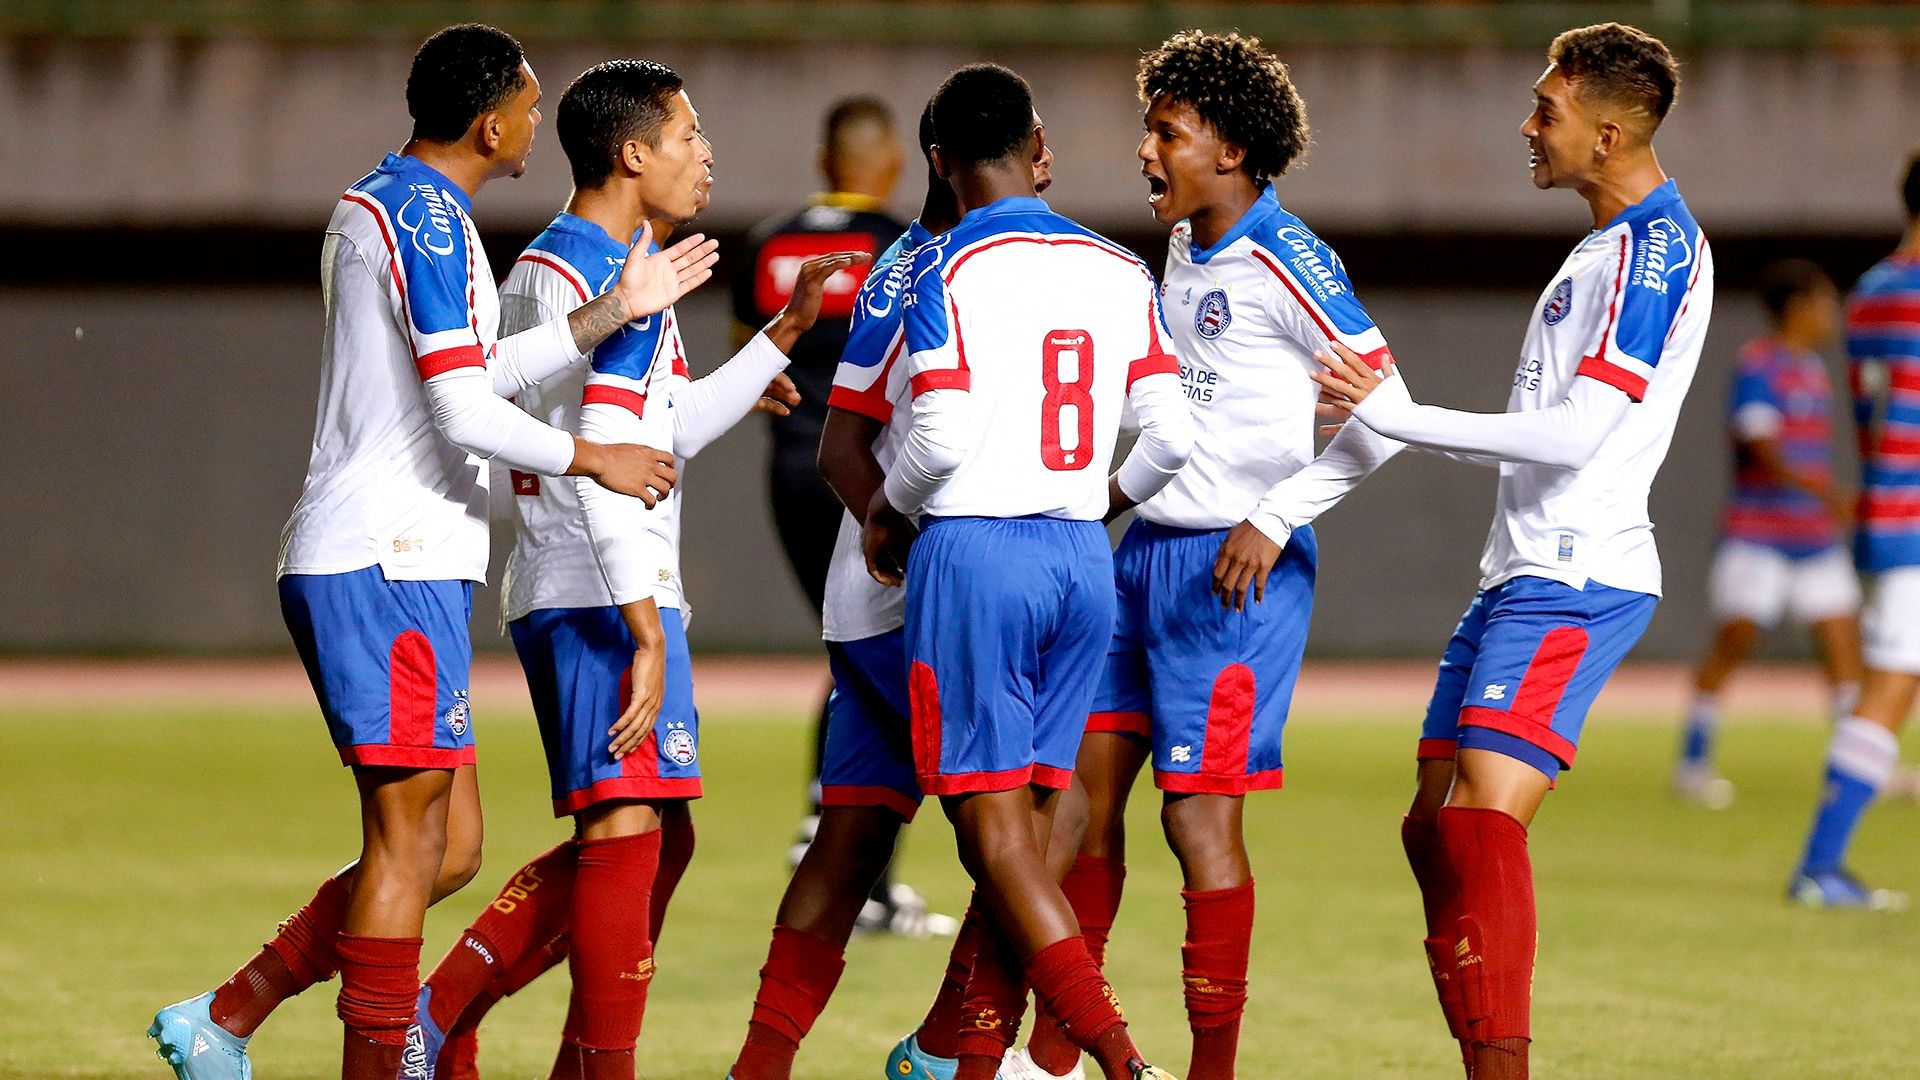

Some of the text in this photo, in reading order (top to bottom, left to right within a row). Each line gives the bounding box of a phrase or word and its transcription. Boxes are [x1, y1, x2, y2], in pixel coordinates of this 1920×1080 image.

[408, 182, 454, 256] Canaã
[1276, 226, 1348, 297] Canaã
[1290, 256, 1329, 303] Alimentos
[1646, 217, 1669, 295] Canaã
[1041, 329, 1094, 471] 8
[1197, 370, 1218, 386] DE
[465, 937, 494, 965] LUPO
